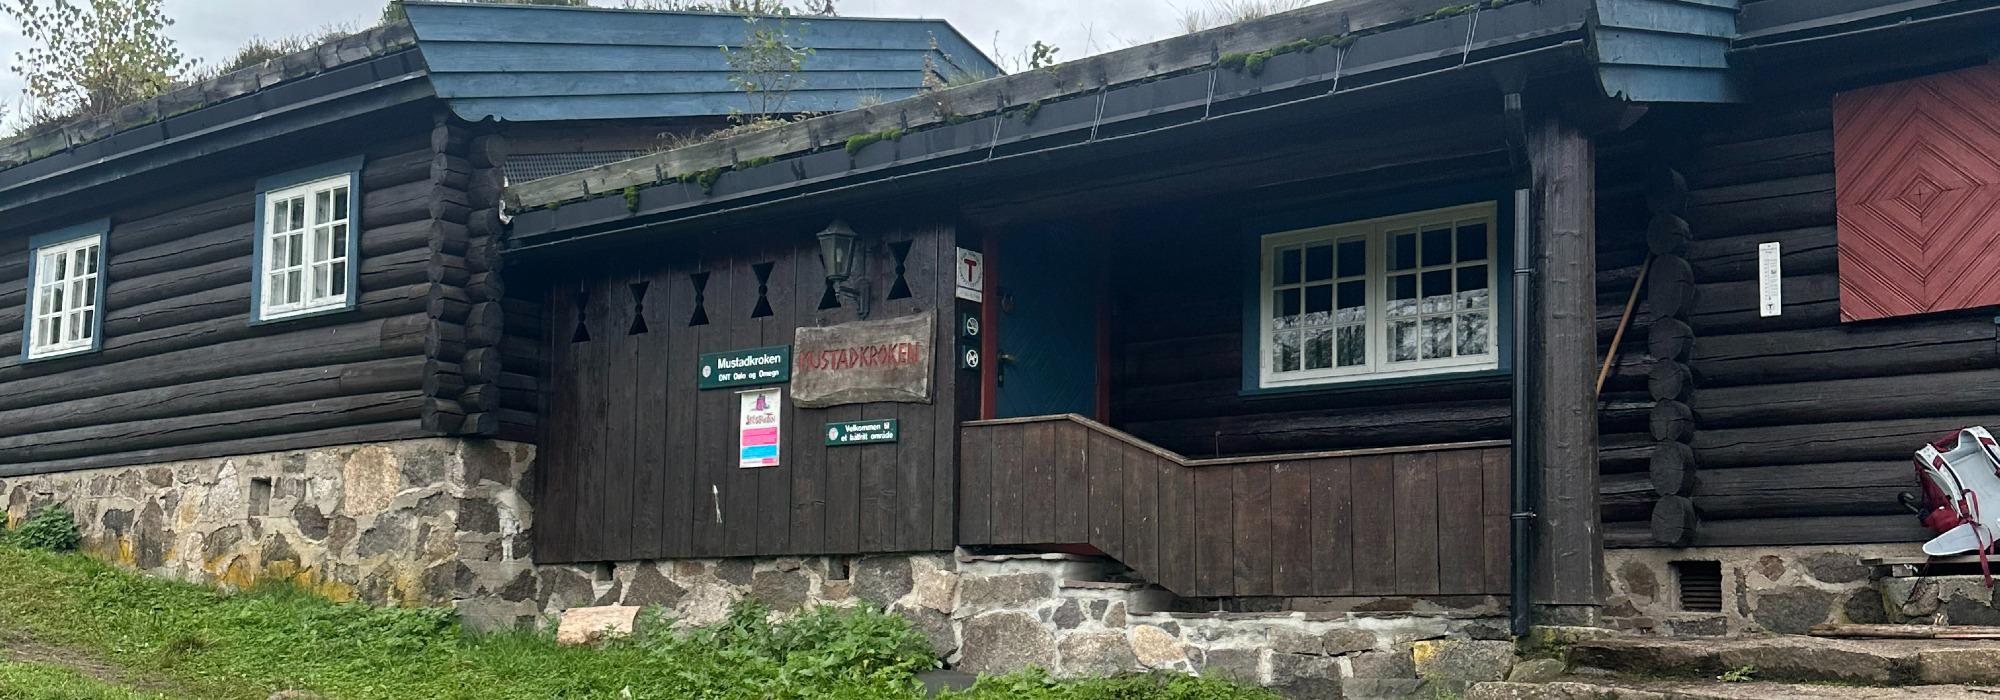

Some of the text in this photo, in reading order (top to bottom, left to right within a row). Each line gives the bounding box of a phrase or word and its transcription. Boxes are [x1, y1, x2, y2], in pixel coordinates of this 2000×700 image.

[963, 258, 977, 283] T
[717, 353, 781, 369] Mustadkroken
[799, 341, 920, 374] MUSTADKROKEN
[718, 369, 780, 382] DNT Oslo og Omegn
[845, 424, 881, 433] Velkommen
[840, 434, 848, 442] et
[870, 430, 894, 440] område
